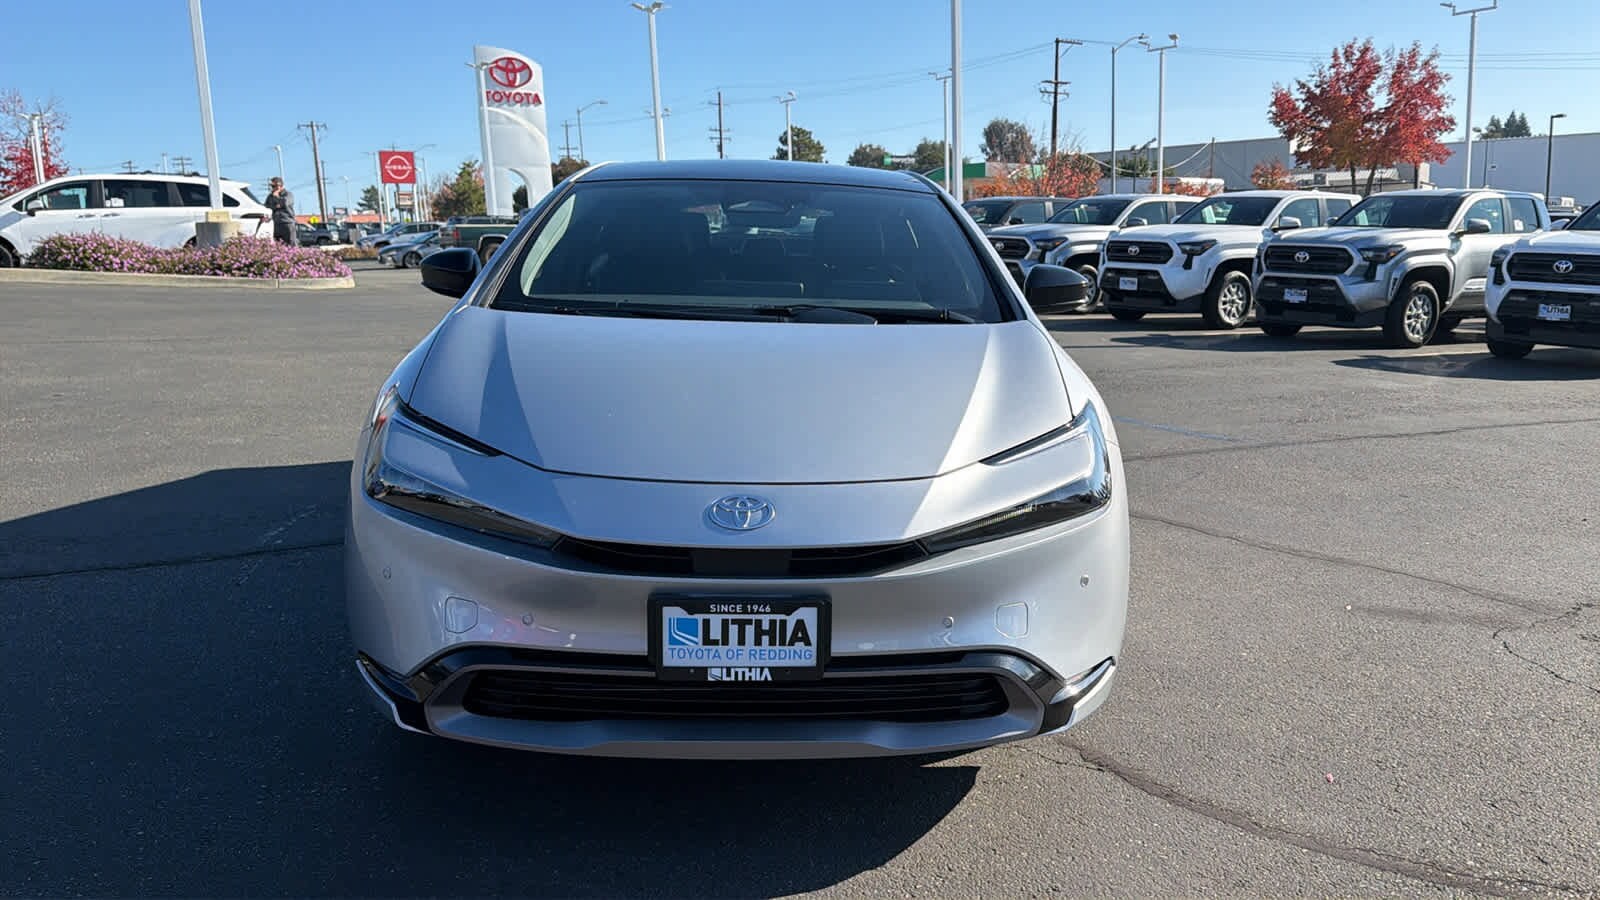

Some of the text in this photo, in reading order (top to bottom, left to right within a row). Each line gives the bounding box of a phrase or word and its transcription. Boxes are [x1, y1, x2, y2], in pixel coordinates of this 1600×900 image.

[485, 90, 542, 104] TOYOTA
[709, 604, 771, 613] SINCE 1946
[702, 618, 812, 647] LITHIA
[668, 647, 813, 660] TOYOTA OF REDDING
[721, 668, 772, 681] LITHIA
